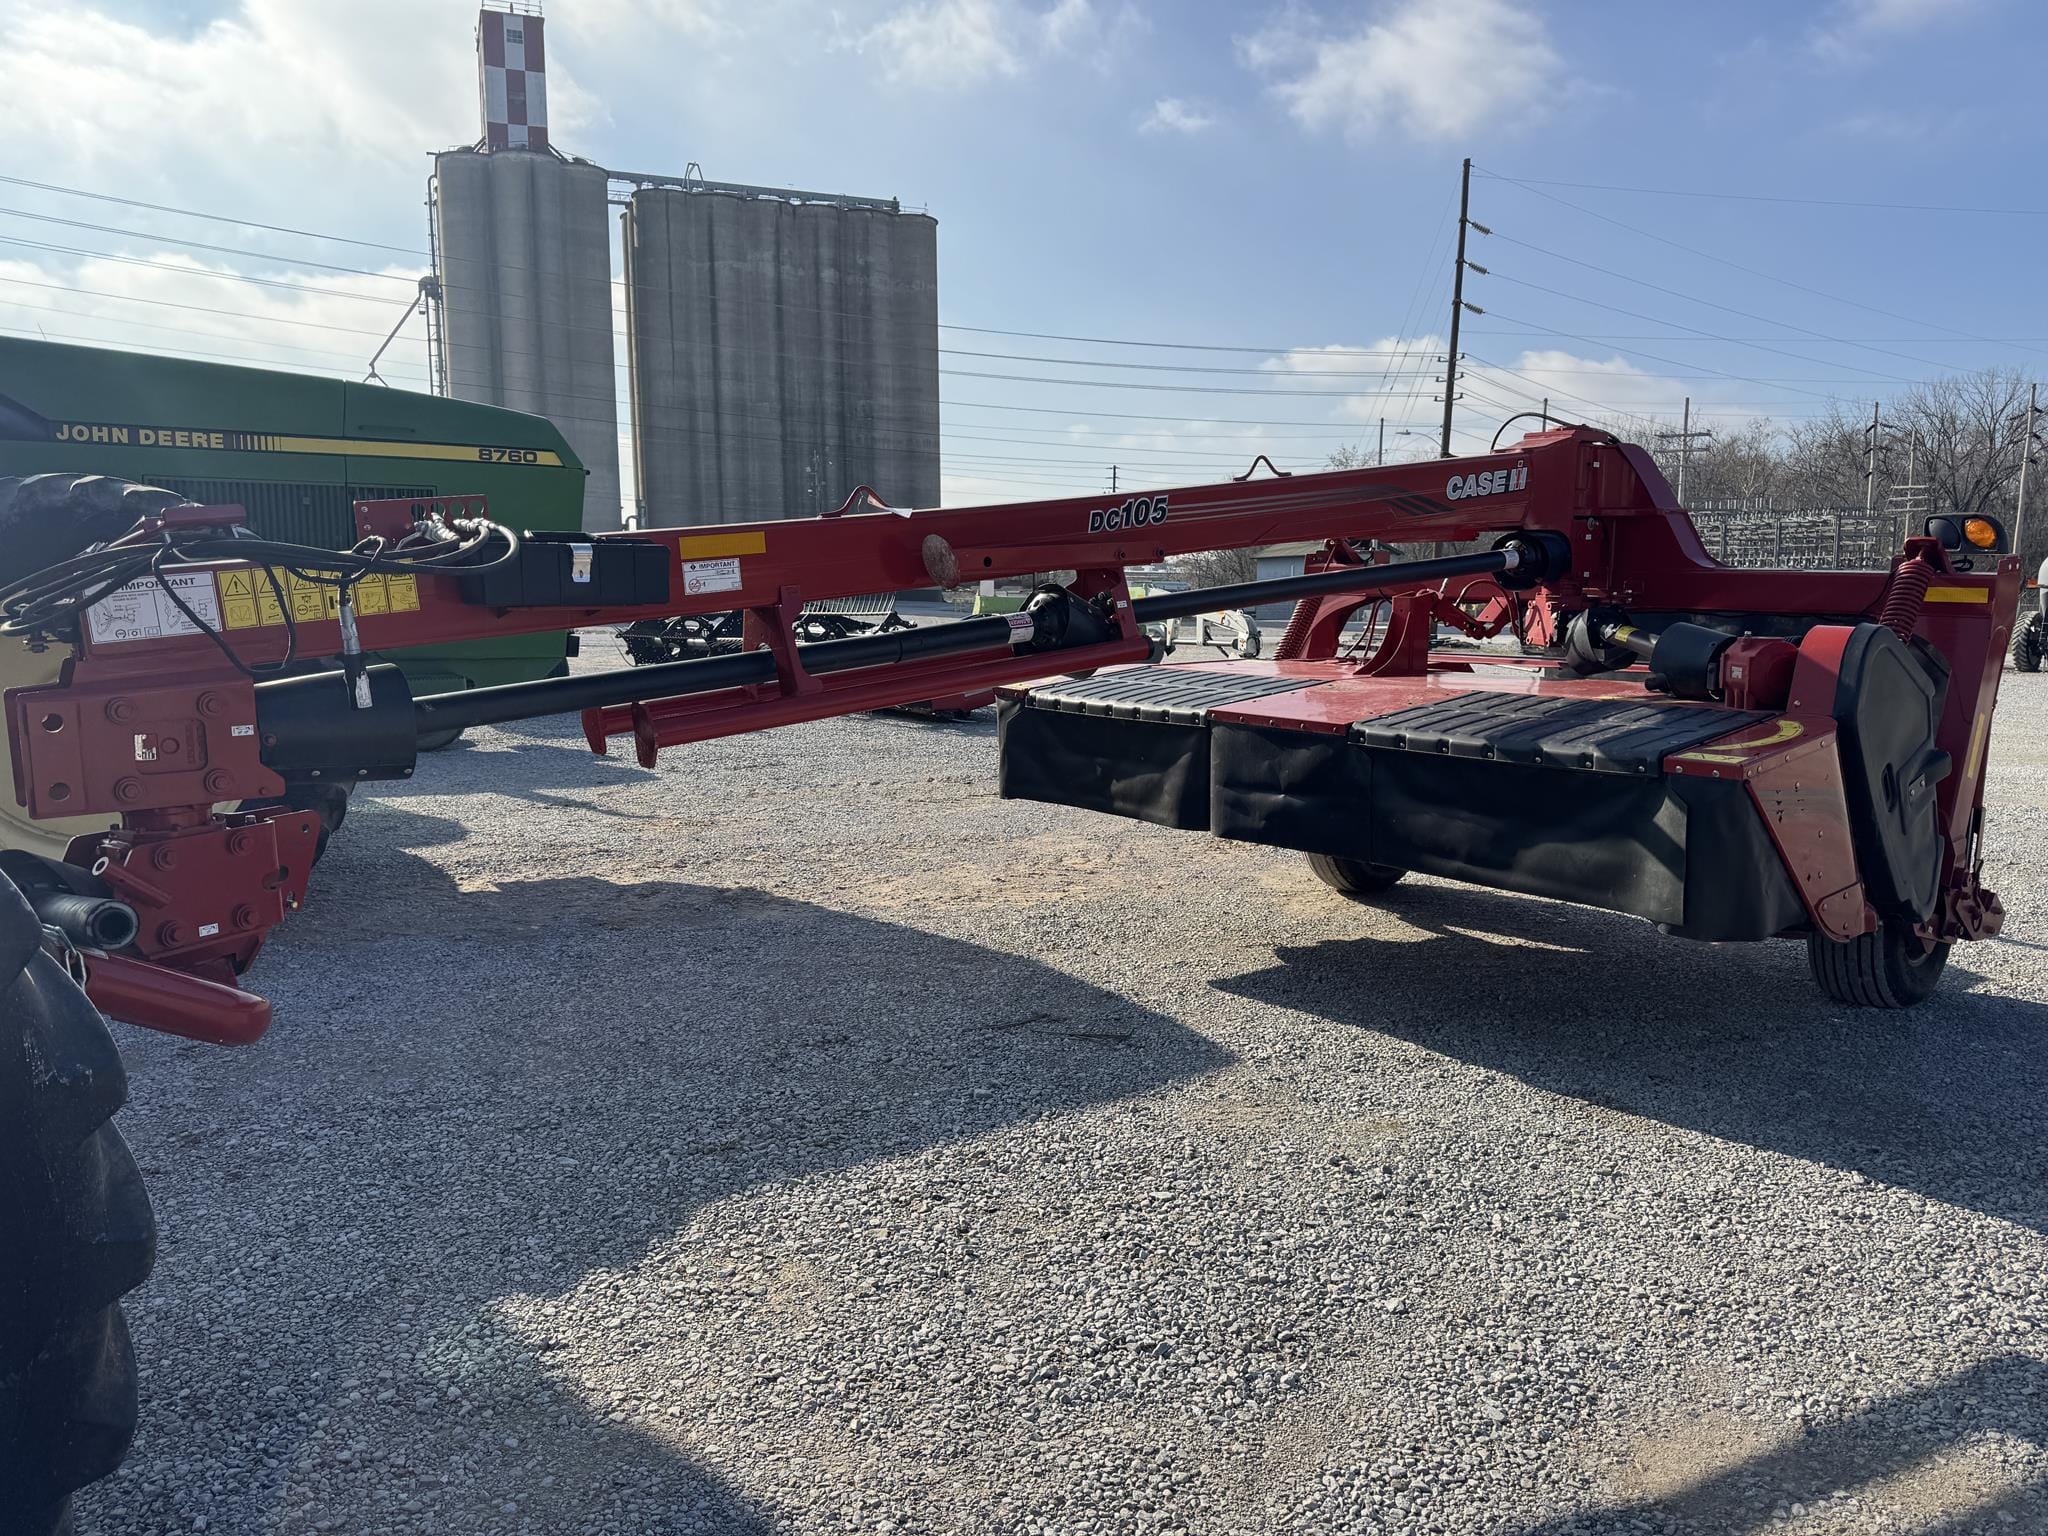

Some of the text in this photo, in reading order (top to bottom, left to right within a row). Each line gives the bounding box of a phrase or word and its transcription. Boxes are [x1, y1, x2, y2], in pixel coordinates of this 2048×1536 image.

[56, 424, 224, 449] JOHN DEERE
[478, 448, 538, 464] 8760
[1446, 470, 1508, 501] CASE
[1087, 495, 1169, 534] DC105
[698, 560, 736, 569] IMPORTANT
